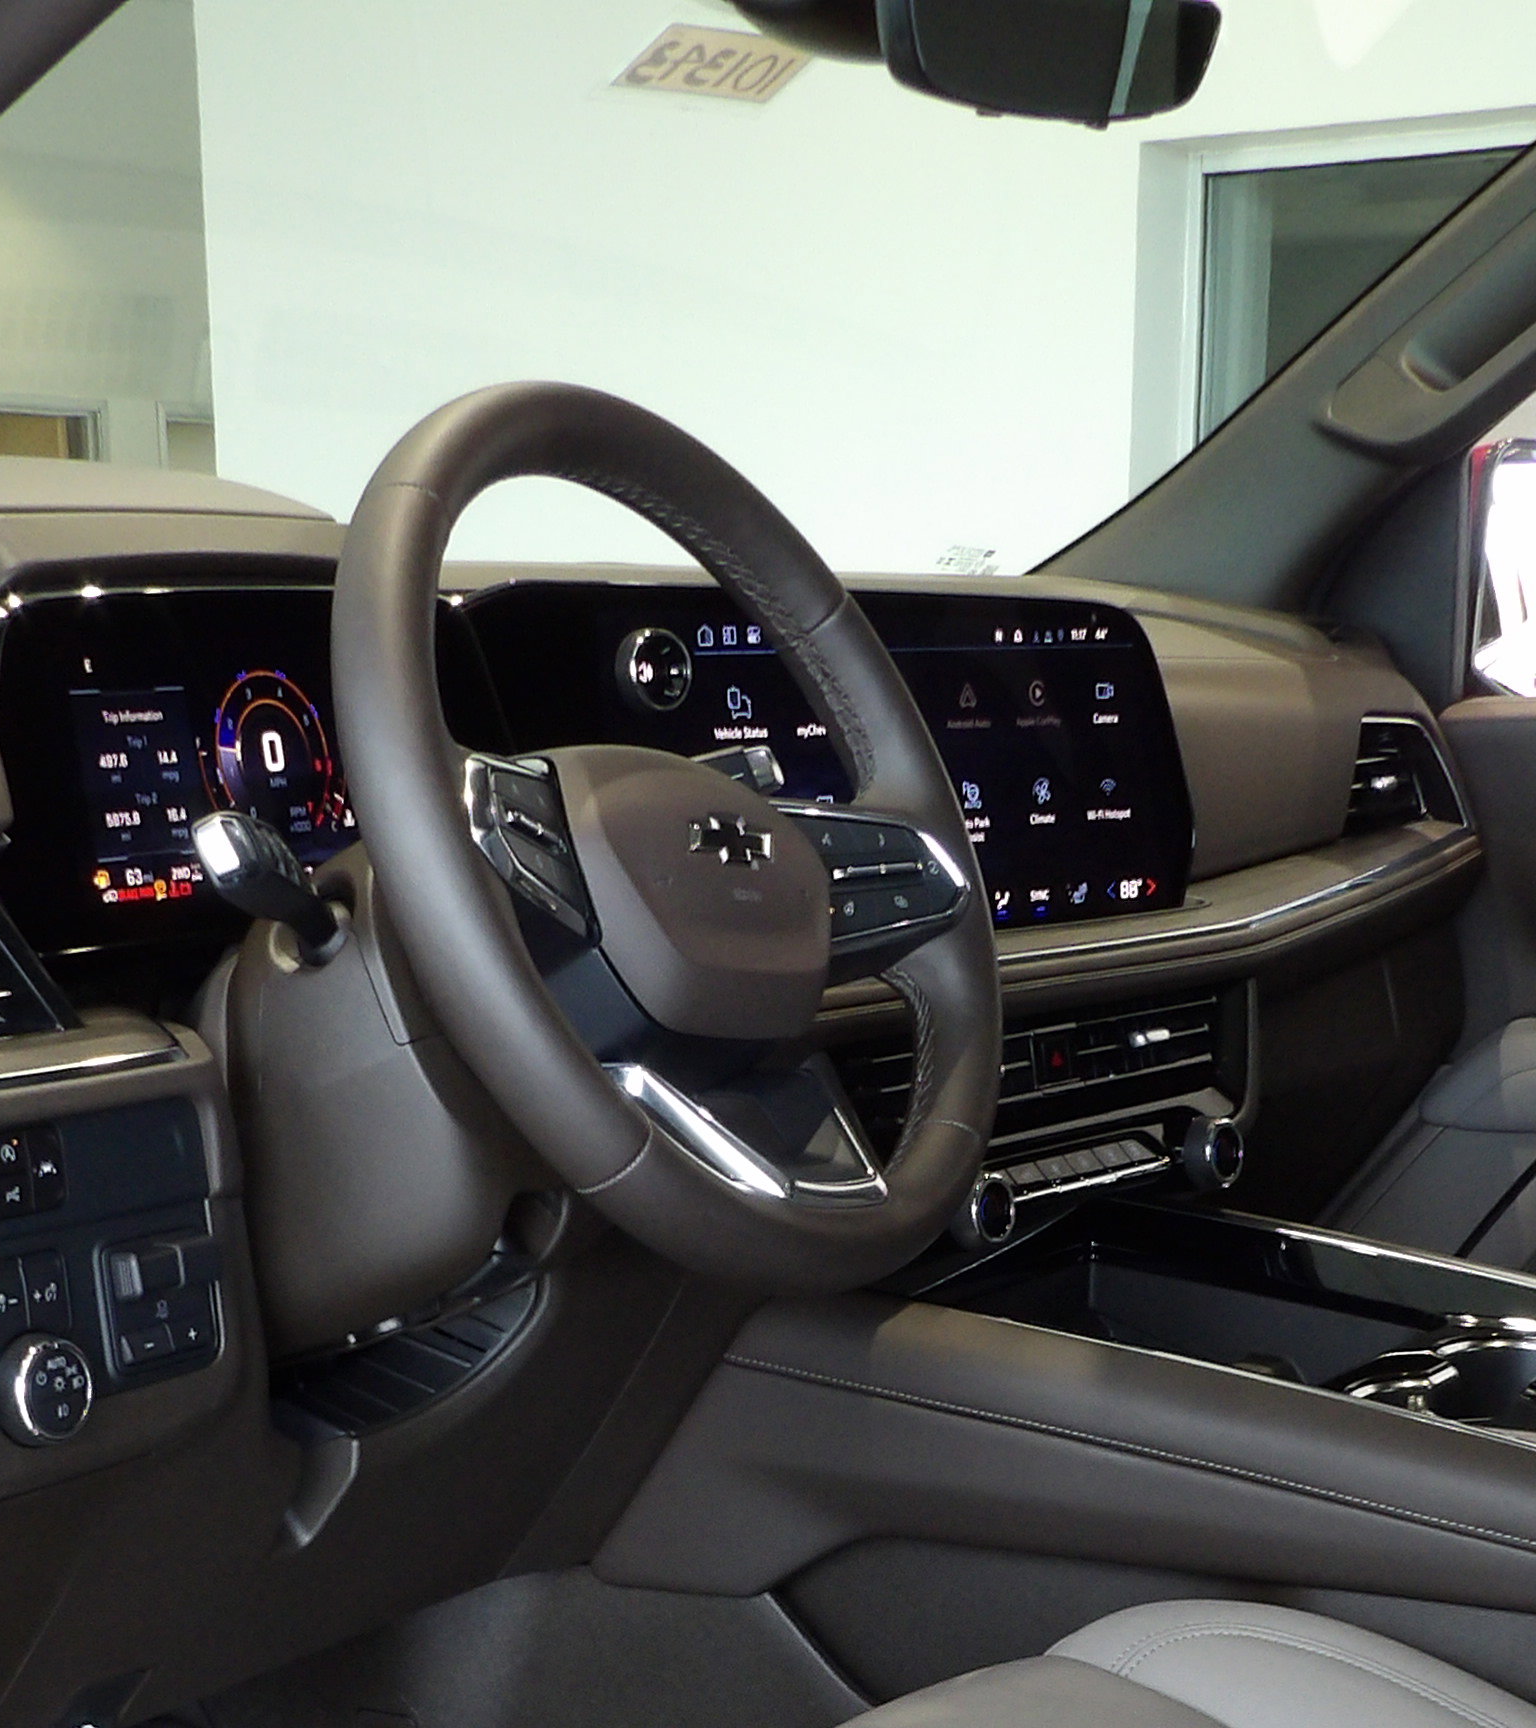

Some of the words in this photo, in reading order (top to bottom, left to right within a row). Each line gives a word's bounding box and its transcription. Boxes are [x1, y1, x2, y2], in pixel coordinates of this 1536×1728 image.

[101, 710, 120, 727] Trip
[120, 709, 164, 723] Information
[1093, 712, 1119, 725] Camera
[714, 726, 743, 740] Vehicle
[743, 726, 768, 740] Status
[262, 730, 285, 773] 0
[1029, 812, 1056, 825] Climate
[1104, 807, 1131, 821] Hotspot
[974, 815, 991, 828] Park
[125, 867, 144, 886] 63
[1029, 888, 1051, 902] SYNC
[46, 1355, 68, 1370] AUTO
